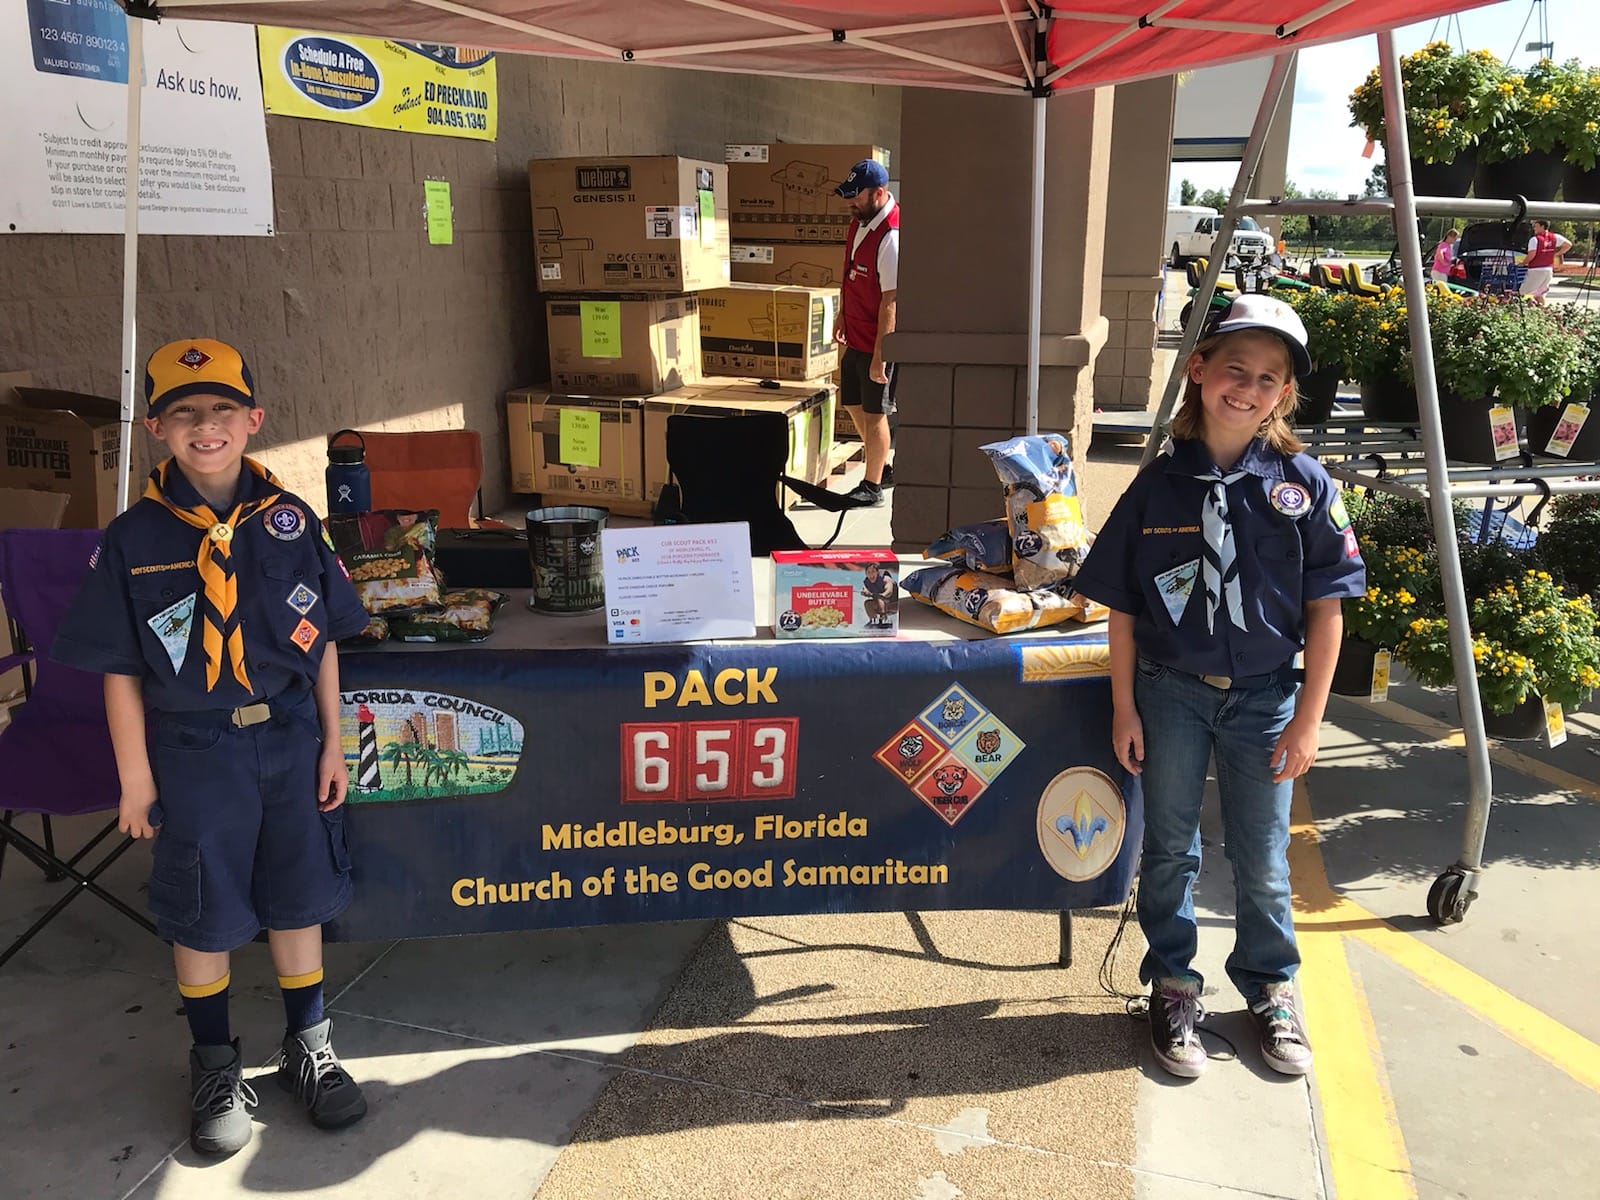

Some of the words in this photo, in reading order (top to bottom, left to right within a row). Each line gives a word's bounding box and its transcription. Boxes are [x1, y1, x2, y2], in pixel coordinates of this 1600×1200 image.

[40, 28, 58, 40] 123
[60, 31, 82, 45] 4567
[85, 35, 118, 52] 890123
[43, 57, 69, 69] VALUED
[69, 61, 100, 73] CUSTOMER
[298, 43, 337, 68] Schedule
[338, 52, 345, 69] A
[346, 53, 364, 73] Free
[157, 68, 185, 92] Ask
[189, 78, 206, 95] us
[209, 76, 242, 101] how.
[290, 59, 321, 81] In-Home
[322, 65, 376, 91] Consultation
[401, 86, 411, 97] or
[424, 81, 436, 102] ED
[392, 93, 422, 115] contact
[426, 106, 488, 131] 904.495.1343
[45, 146, 78, 158] Minimum
[79, 151, 109, 162] monthly
[146, 156, 174, 166] required
[175, 158, 184, 166] for
[185, 158, 207, 168] Special
[70, 137, 79, 145] to
[79, 138, 102, 148] credit
[173, 147, 190, 158] apply
[190, 148, 197, 156] to
[55, 162, 70, 170] your
[72, 163, 104, 173] purchase
[144, 168, 159, 176] over
[161, 168, 172, 177] the
[173, 171, 201, 179] minimum
[580, 168, 617, 188] weber
[48, 173, 62, 182] will
[63, 174, 72, 183] be
[73, 175, 94, 184] asked
[95, 176, 102, 185] to
[103, 177, 126, 186] select
[157, 181, 170, 189] you
[171, 181, 189, 190] would
[204, 183, 215, 191] See
[217, 184, 246, 193] disclosure
[50, 185, 64, 195] slip
[73, 187, 91, 196] store
[92, 187, 102, 197] for
[573, 194, 625, 204] GENESIS
[6, 436, 69, 452] UNBELIEVABLE
[8, 449, 71, 471] BUTTER
[1143, 527, 1153, 535] BOY
[1178, 525, 1200, 534] AMERICA
[353, 552, 383, 561] CARAMEL
[616, 546, 640, 558] PACK
[131, 567, 144, 576] BOY
[143, 564, 165, 574] SCOUTS
[170, 560, 196, 570] AMERICA
[796, 591, 849, 599] UNBELIEVABLE
[643, 667, 779, 708] PACK
[340, 692, 415, 705] LORIDA
[424, 695, 505, 726] COUNCIL
[937, 719, 968, 730] BOBCAT
[633, 727, 787, 793] 653
[899, 758, 922, 767] WOLF
[974, 753, 1003, 764] BEAR
[932, 795, 953, 805] TIGER
[953, 795, 969, 805] CUB
[541, 818, 745, 851] Middleburg,
[754, 811, 869, 841] Florida
[451, 872, 572, 907] Church
[581, 870, 618, 898] of
[623, 867, 679, 895] the
[687, 859, 774, 891] Good
[782, 858, 950, 888] Samaritan
